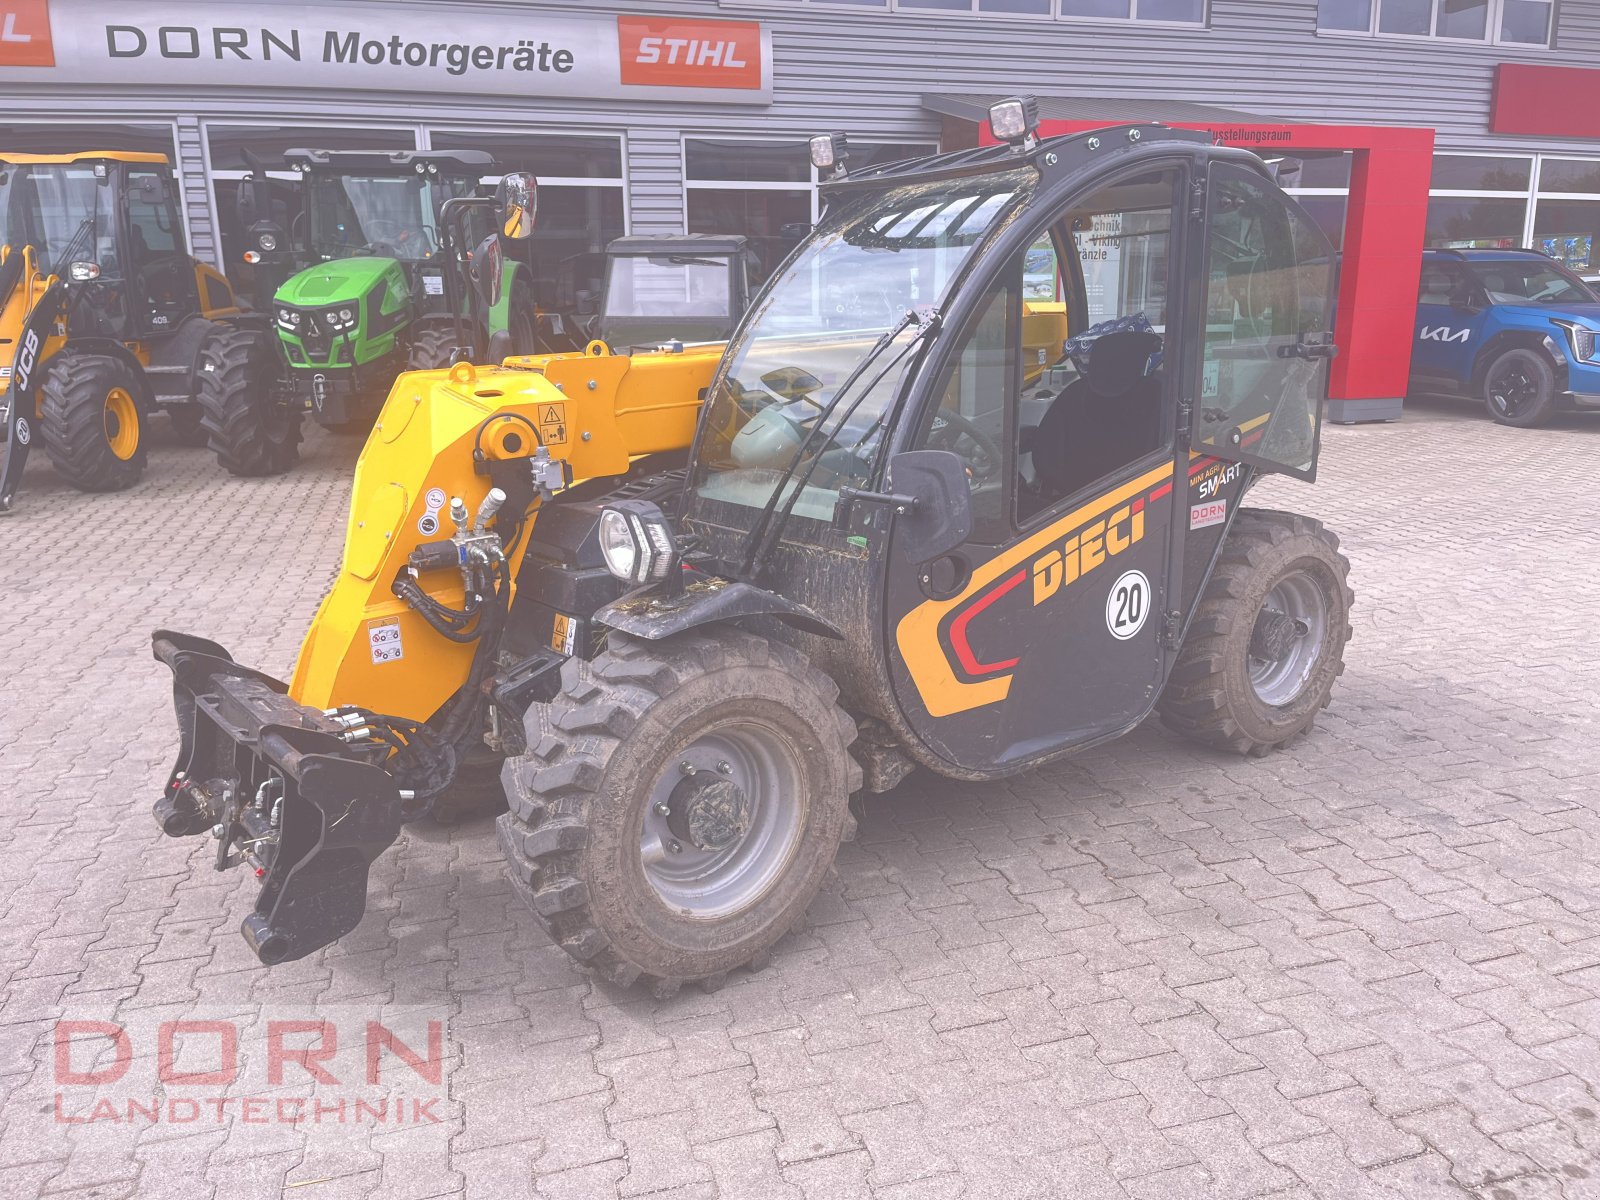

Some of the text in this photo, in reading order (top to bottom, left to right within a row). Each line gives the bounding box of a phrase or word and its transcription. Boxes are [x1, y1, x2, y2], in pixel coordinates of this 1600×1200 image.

[105, 25, 575, 76] DORN Motorgeräte
[635, 37, 748, 68] STIHL
[1208, 127, 1292, 144] usstellungsraum
[1093, 219, 1121, 232] chnik
[1420, 325, 1471, 344] KIA
[18, 328, 39, 392] JCB
[1189, 472, 1204, 488] MINI
[1199, 461, 1242, 499] SMART
[1191, 504, 1225, 520] DORN
[1115, 582, 1142, 629] 20
